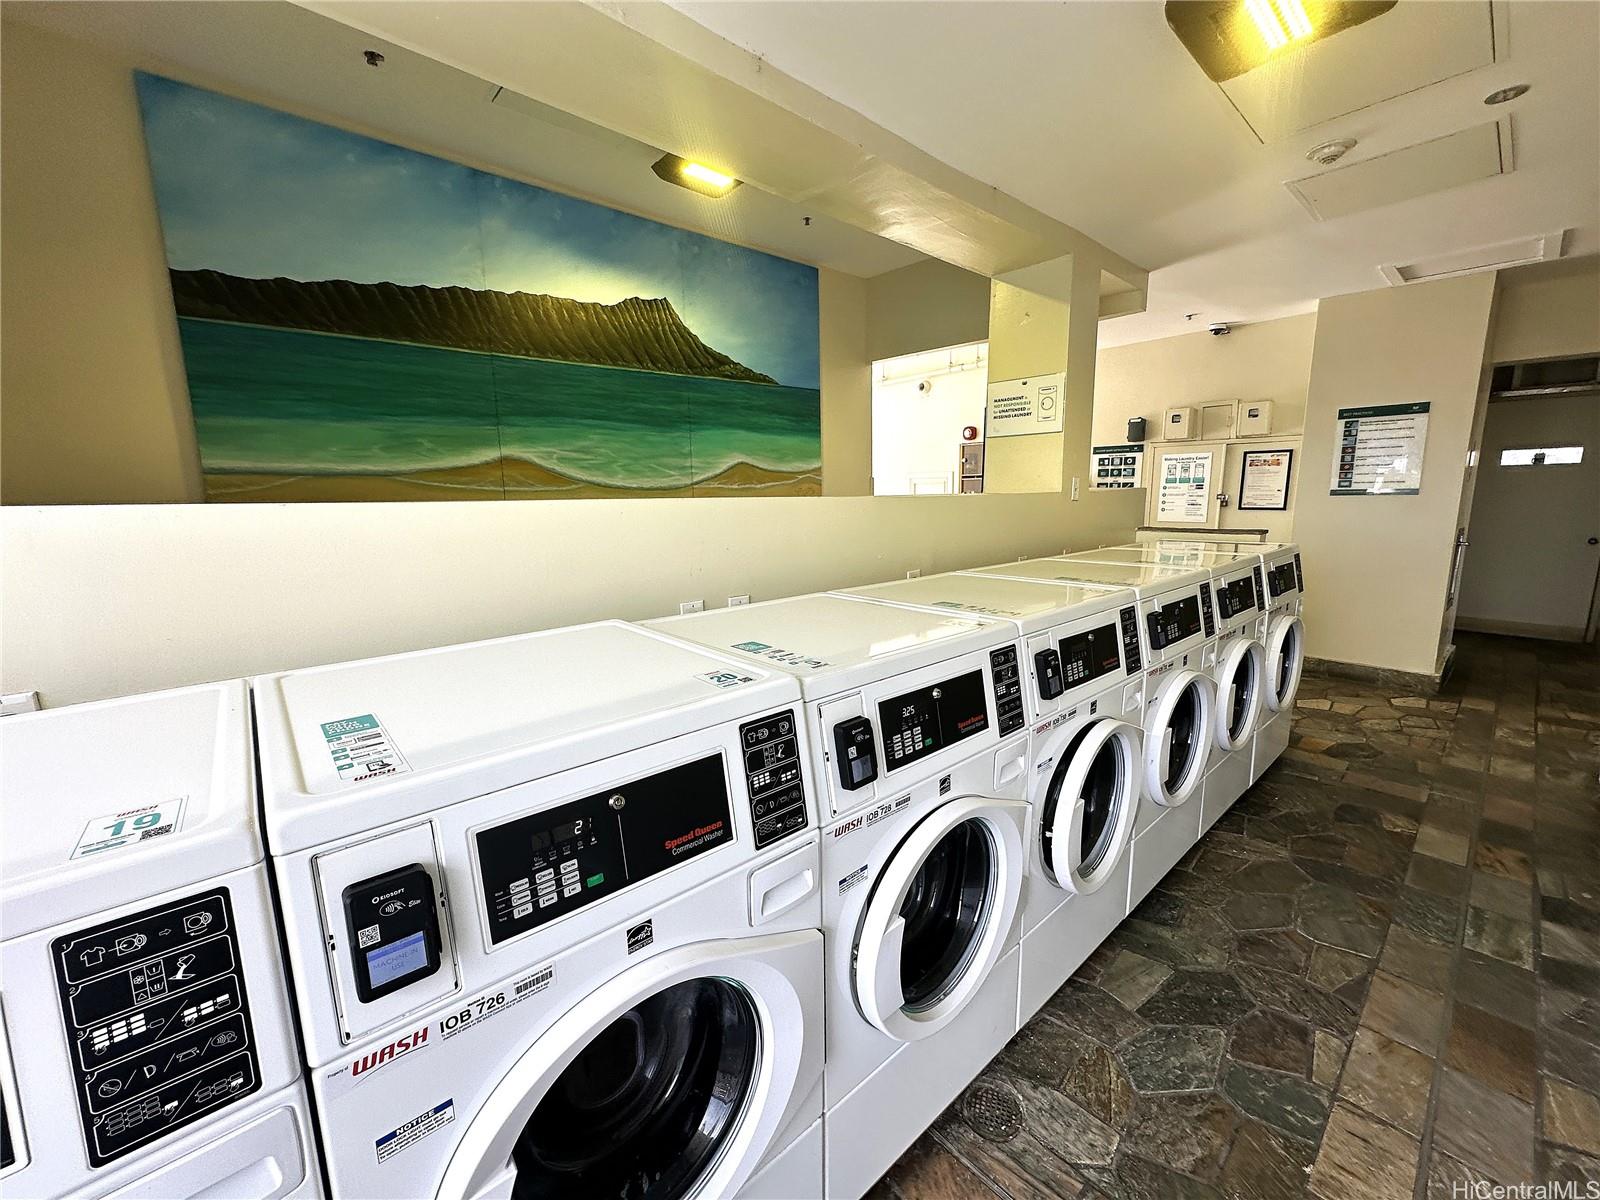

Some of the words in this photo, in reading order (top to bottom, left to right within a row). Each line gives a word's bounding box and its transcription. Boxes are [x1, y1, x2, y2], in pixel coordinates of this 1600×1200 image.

[710, 674, 738, 683] 20
[104, 813, 162, 837] 19
[574, 820, 583, 834] 2
[834, 817, 863, 838] WASH
[866, 811, 879, 822] IOB
[880, 804, 892, 815] 728
[665, 831, 694, 849] Speed
[695, 821, 722, 836] Queen
[672, 837, 704, 855] Commercial
[704, 829, 723, 841] Washer
[380, 888, 405, 900] KIOSOFT
[373, 953, 409, 969] MACHINE
[391, 963, 404, 972] USE
[440, 1009, 472, 1034] IOB
[476, 992, 505, 1015] 726
[352, 1026, 428, 1076] WASH
[395, 1109, 434, 1135] NOTICE
[378, 1141, 392, 1152] DOOR
[393, 1133, 406, 1143] LOCK
[407, 1125, 421, 1135] LIGHT
